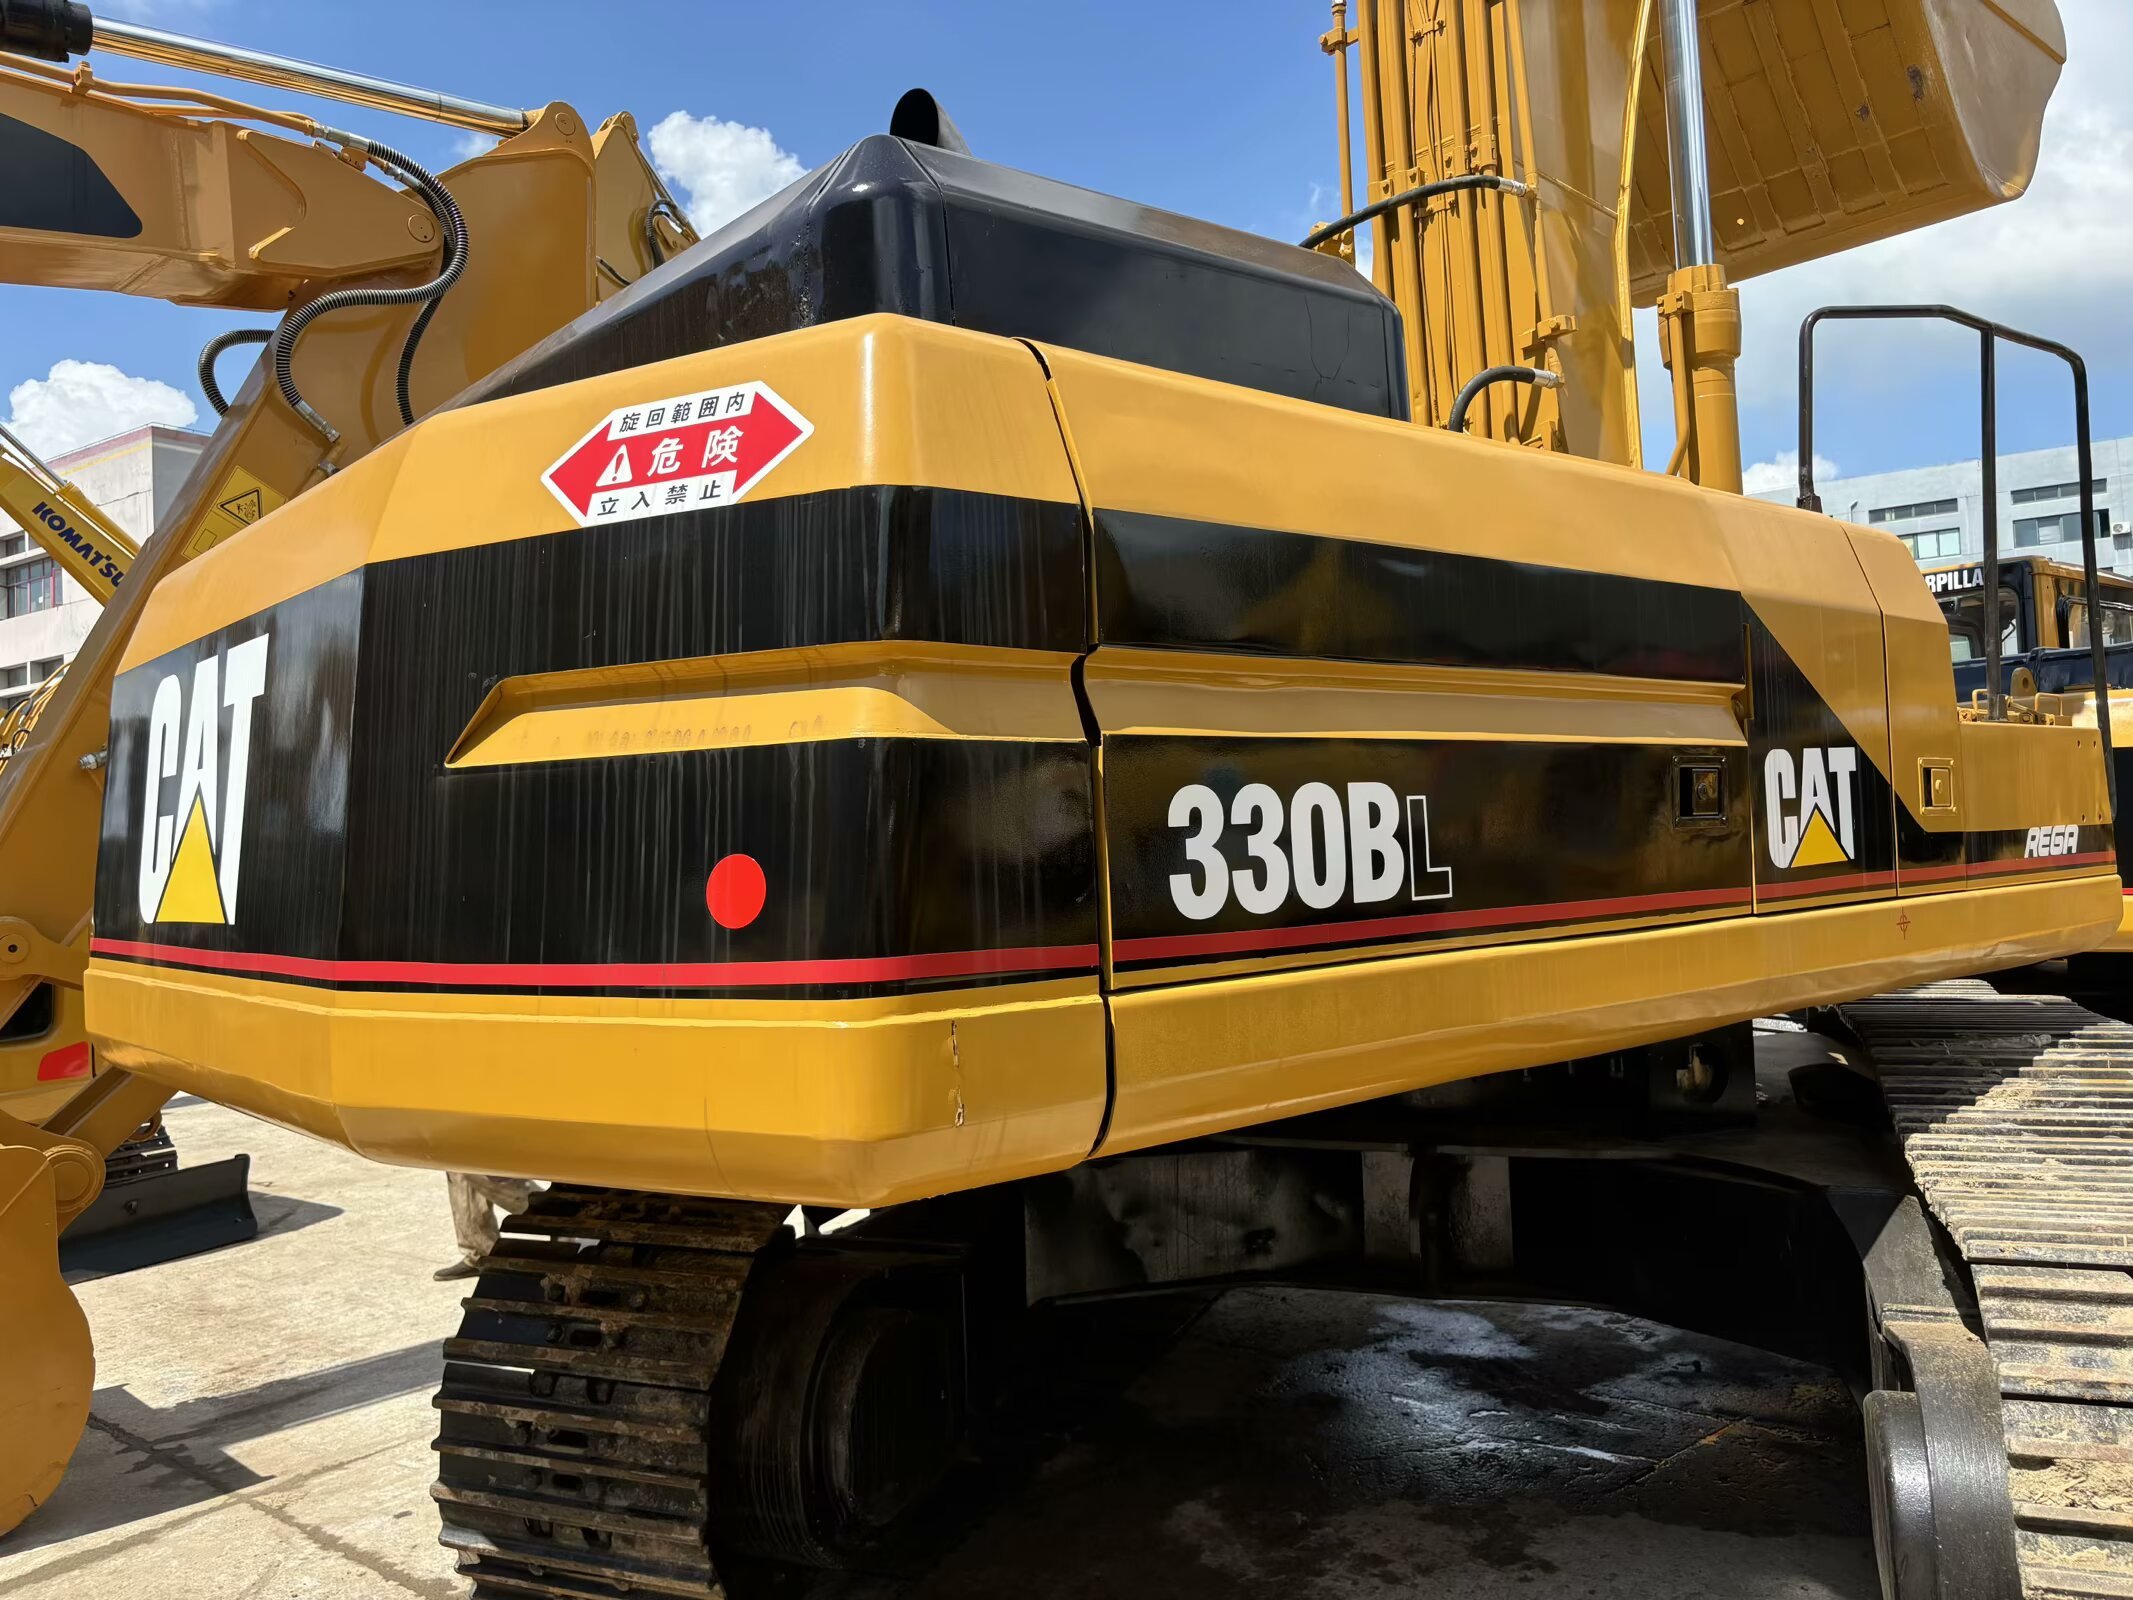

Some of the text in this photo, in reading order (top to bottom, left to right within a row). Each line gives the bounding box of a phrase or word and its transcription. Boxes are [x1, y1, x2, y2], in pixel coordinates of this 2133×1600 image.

[619, 391, 745, 433] 旋回範囲内
[646, 425, 744, 477] 危険
[597, 480, 722, 516] 立入禁止
[1924, 567, 1984, 593] RPILLA
[139, 633, 269, 925] CAT
[1764, 747, 1856, 869] CAT
[2024, 824, 2079, 859] REGA
